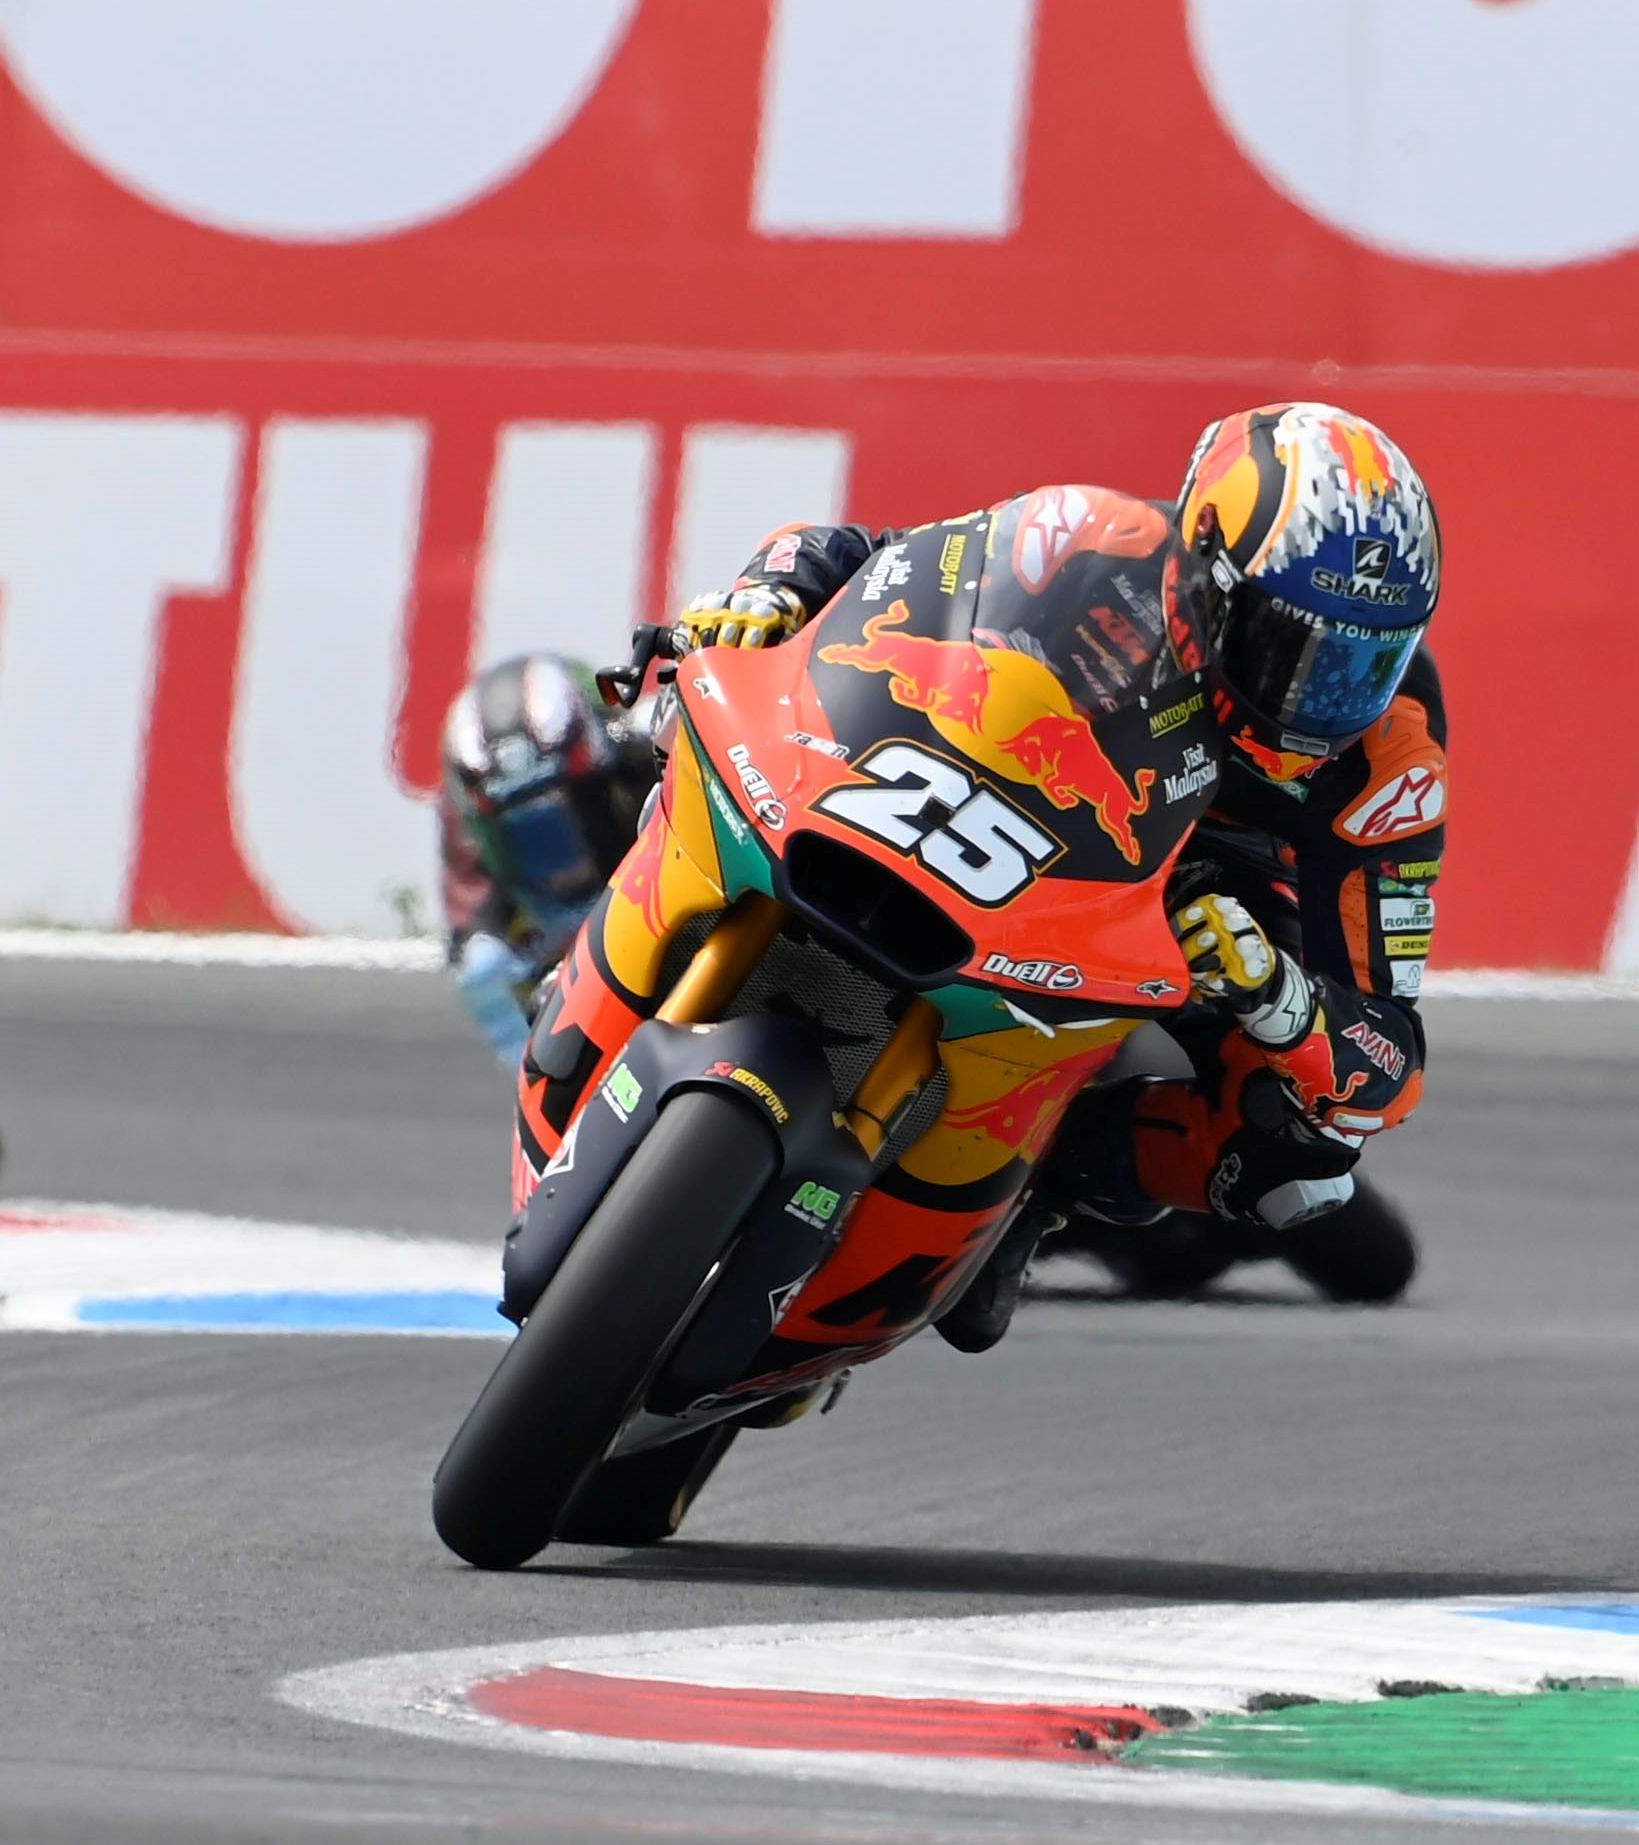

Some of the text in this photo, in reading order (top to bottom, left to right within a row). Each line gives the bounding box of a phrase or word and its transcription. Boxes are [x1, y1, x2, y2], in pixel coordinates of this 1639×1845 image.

[1311, 567, 1411, 606] SHARK
[1271, 597, 1325, 629] GIVES
[1335, 620, 1372, 640] YOU
[1182, 742, 1206, 770] Visit
[1164, 759, 1218, 804] Malaysia
[818, 745, 1055, 904] 25
